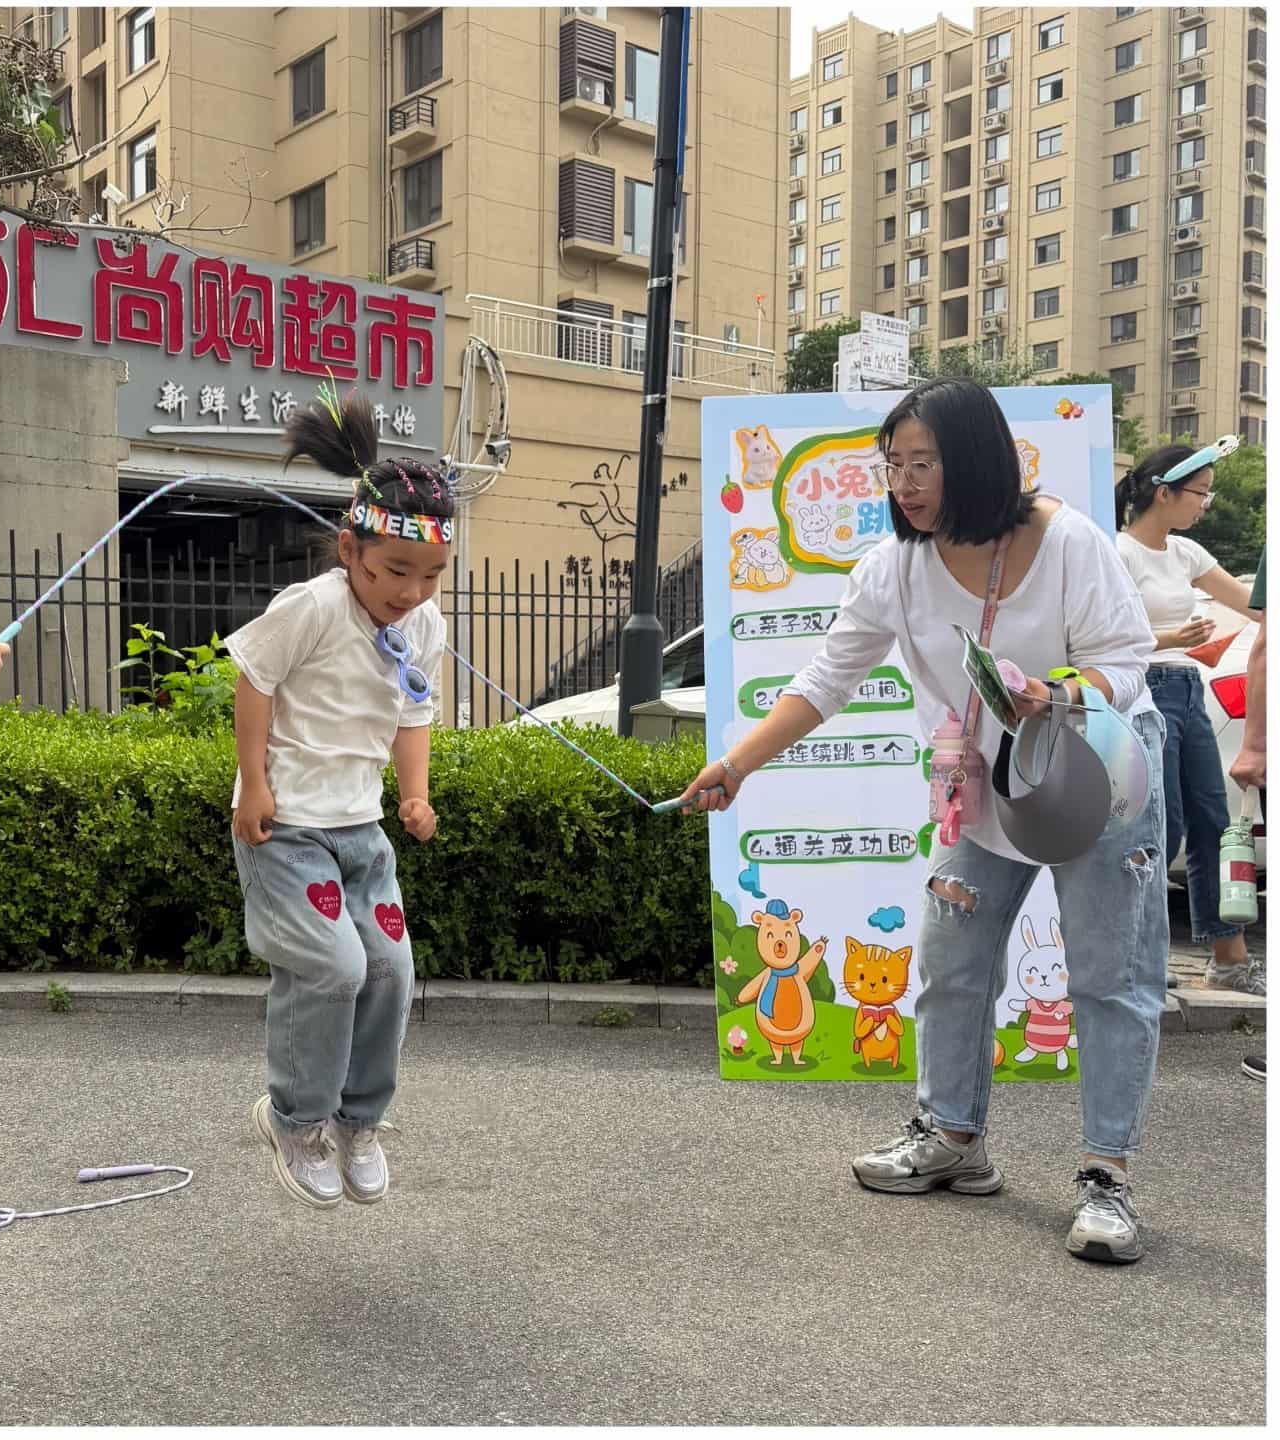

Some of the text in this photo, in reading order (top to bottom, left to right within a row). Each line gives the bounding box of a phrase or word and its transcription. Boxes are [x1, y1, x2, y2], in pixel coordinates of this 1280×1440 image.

[354, 505, 452, 542] SWEETS
[750, 833, 912, 858] 4.通关成功即
